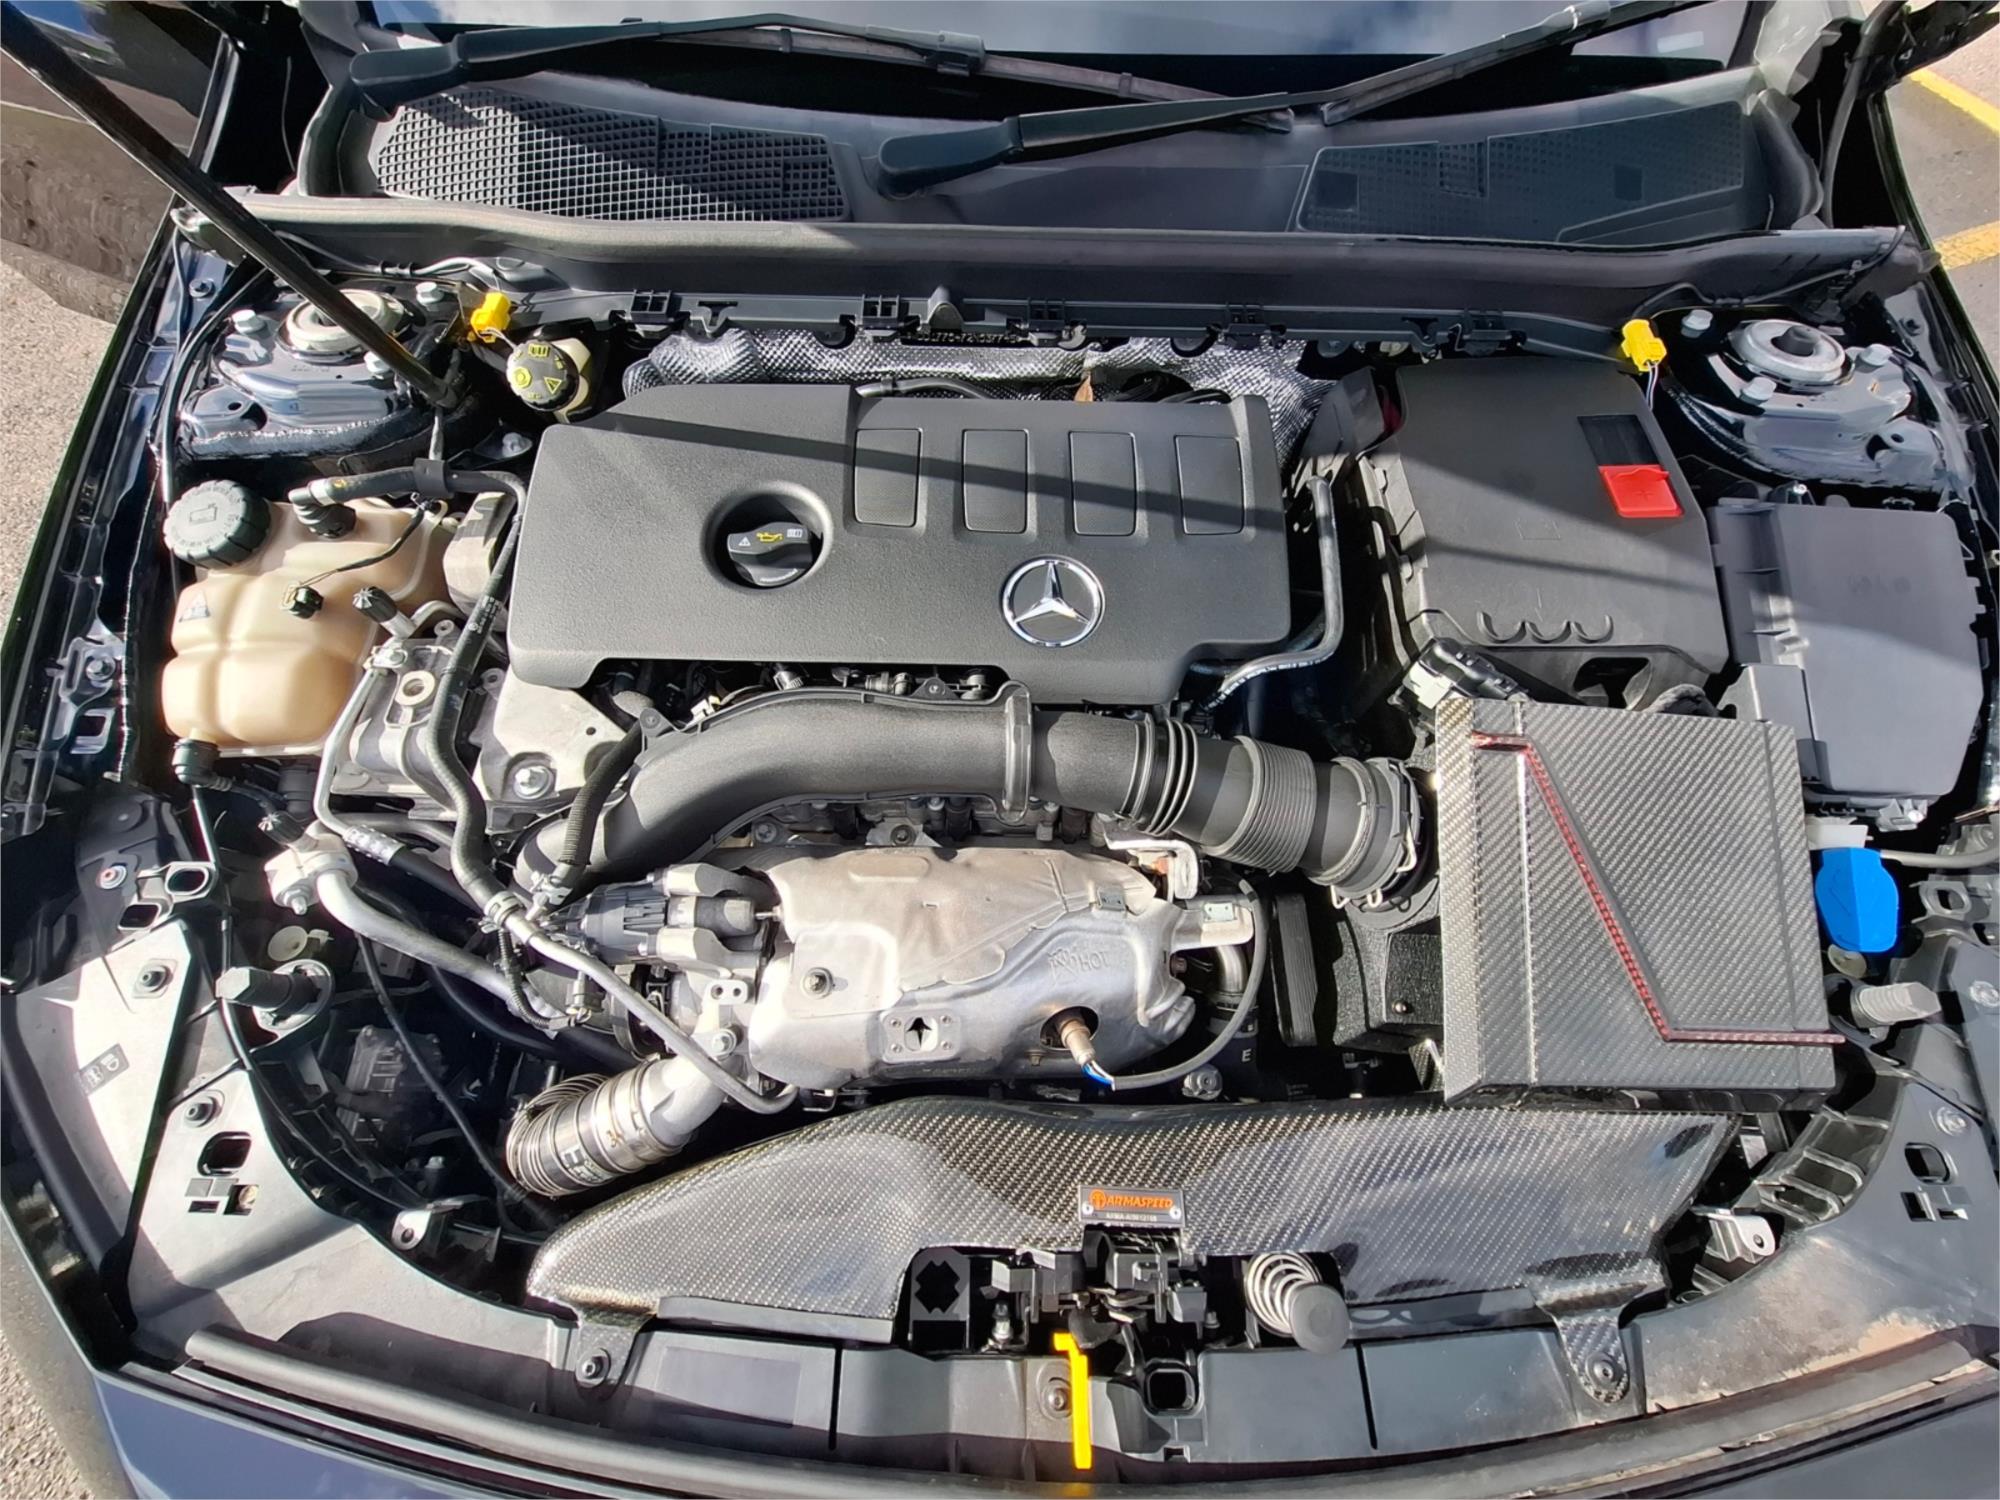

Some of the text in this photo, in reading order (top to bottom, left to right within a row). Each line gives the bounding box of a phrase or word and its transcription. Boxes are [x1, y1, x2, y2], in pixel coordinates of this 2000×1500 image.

[1078, 951, 1109, 972] HOT
[1241, 1048, 1252, 1062] E
[1105, 1194, 1174, 1209] ARMASPEED
